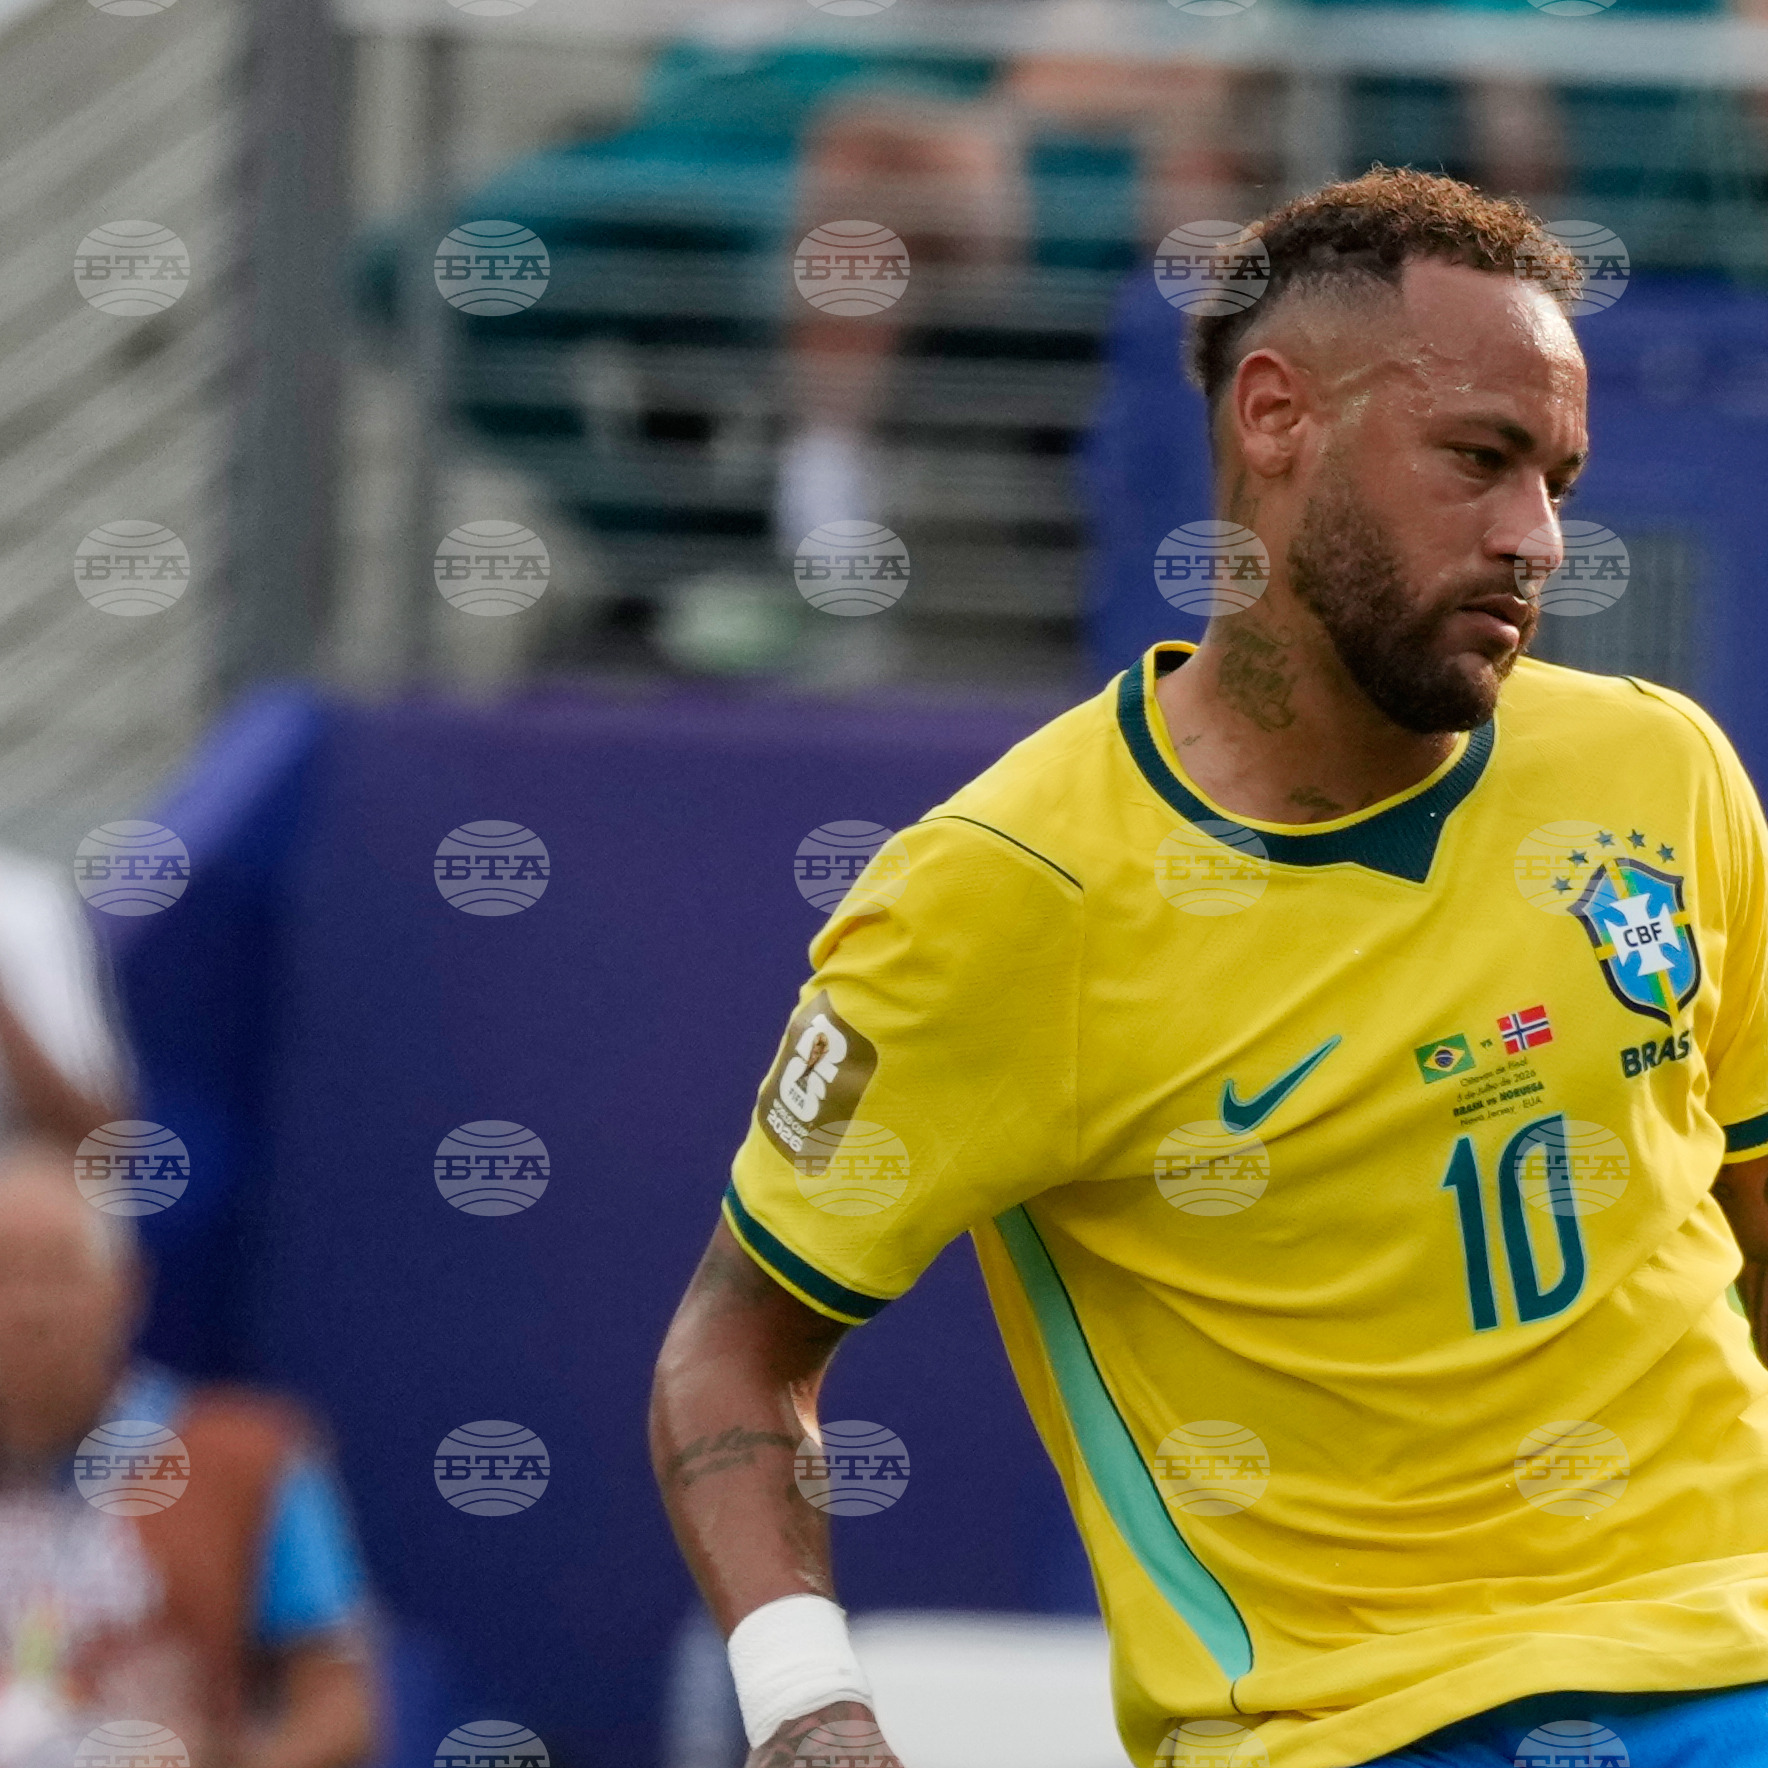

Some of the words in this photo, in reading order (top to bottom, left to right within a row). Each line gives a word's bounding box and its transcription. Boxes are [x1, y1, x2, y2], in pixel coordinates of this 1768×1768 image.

[1622, 921, 1663, 948] CBF
[1513, 1069, 1537, 1083] 2026
[1620, 1029, 1691, 1079] BRAS
[766, 1108, 804, 1153] 2026
[1440, 1110, 1588, 1332] 10
